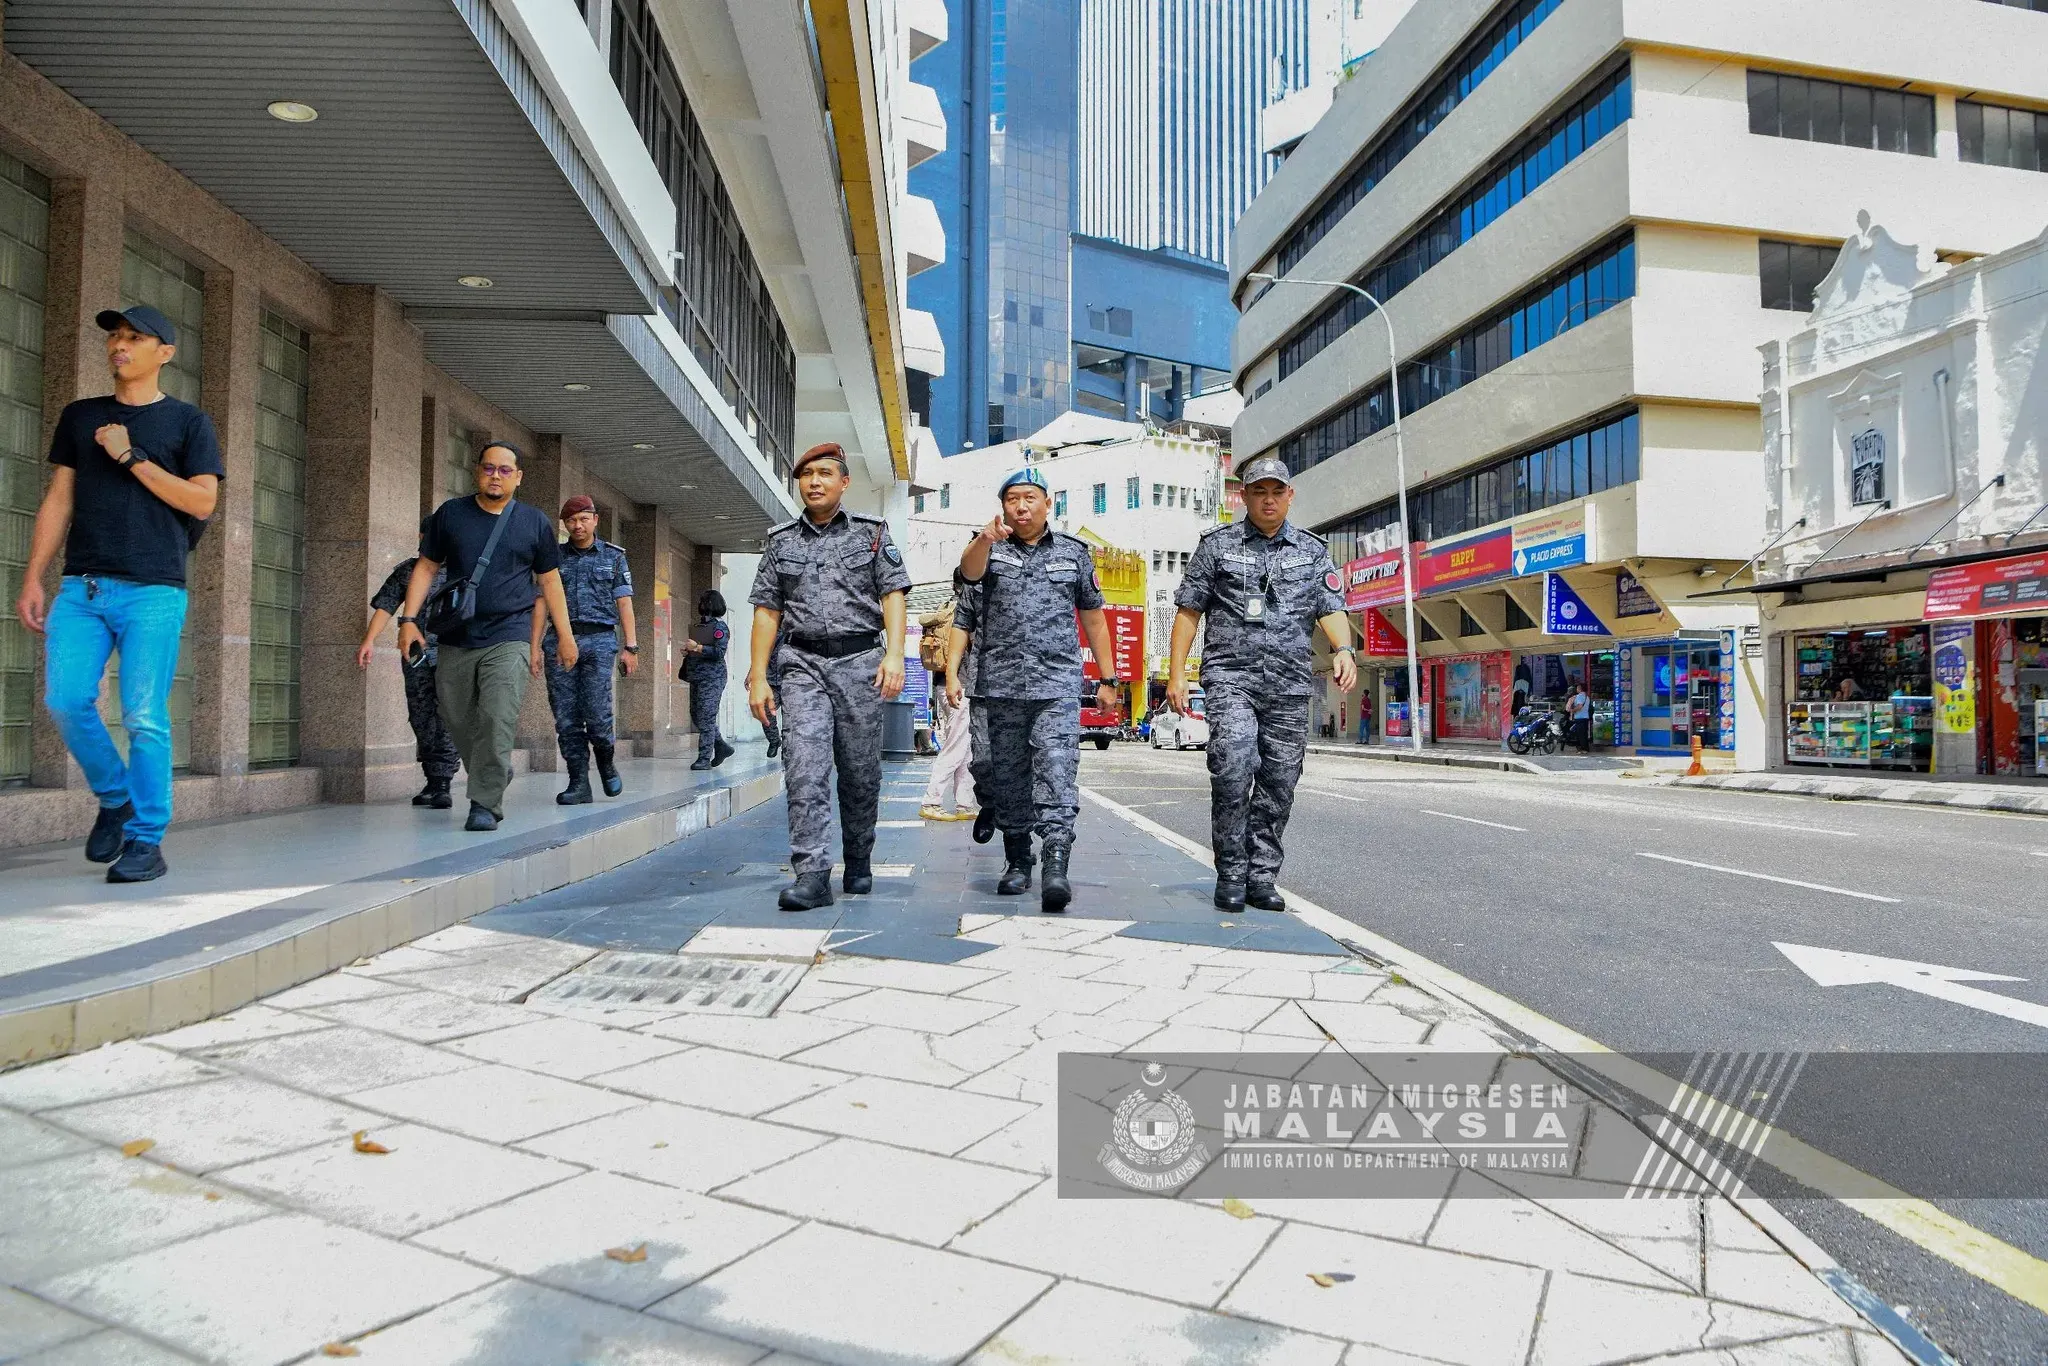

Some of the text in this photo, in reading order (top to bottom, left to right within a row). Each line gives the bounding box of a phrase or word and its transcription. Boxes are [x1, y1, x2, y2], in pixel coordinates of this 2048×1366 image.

[1451, 549, 1475, 568] HAPPY
[1530, 550, 1549, 563] PLACID
[1550, 544, 1574, 559] EXPRESS
[1352, 564, 1379, 585] HAPPY
[1379, 560, 1400, 578] TRIP
[1556, 624, 1599, 632] EXCHANGE
